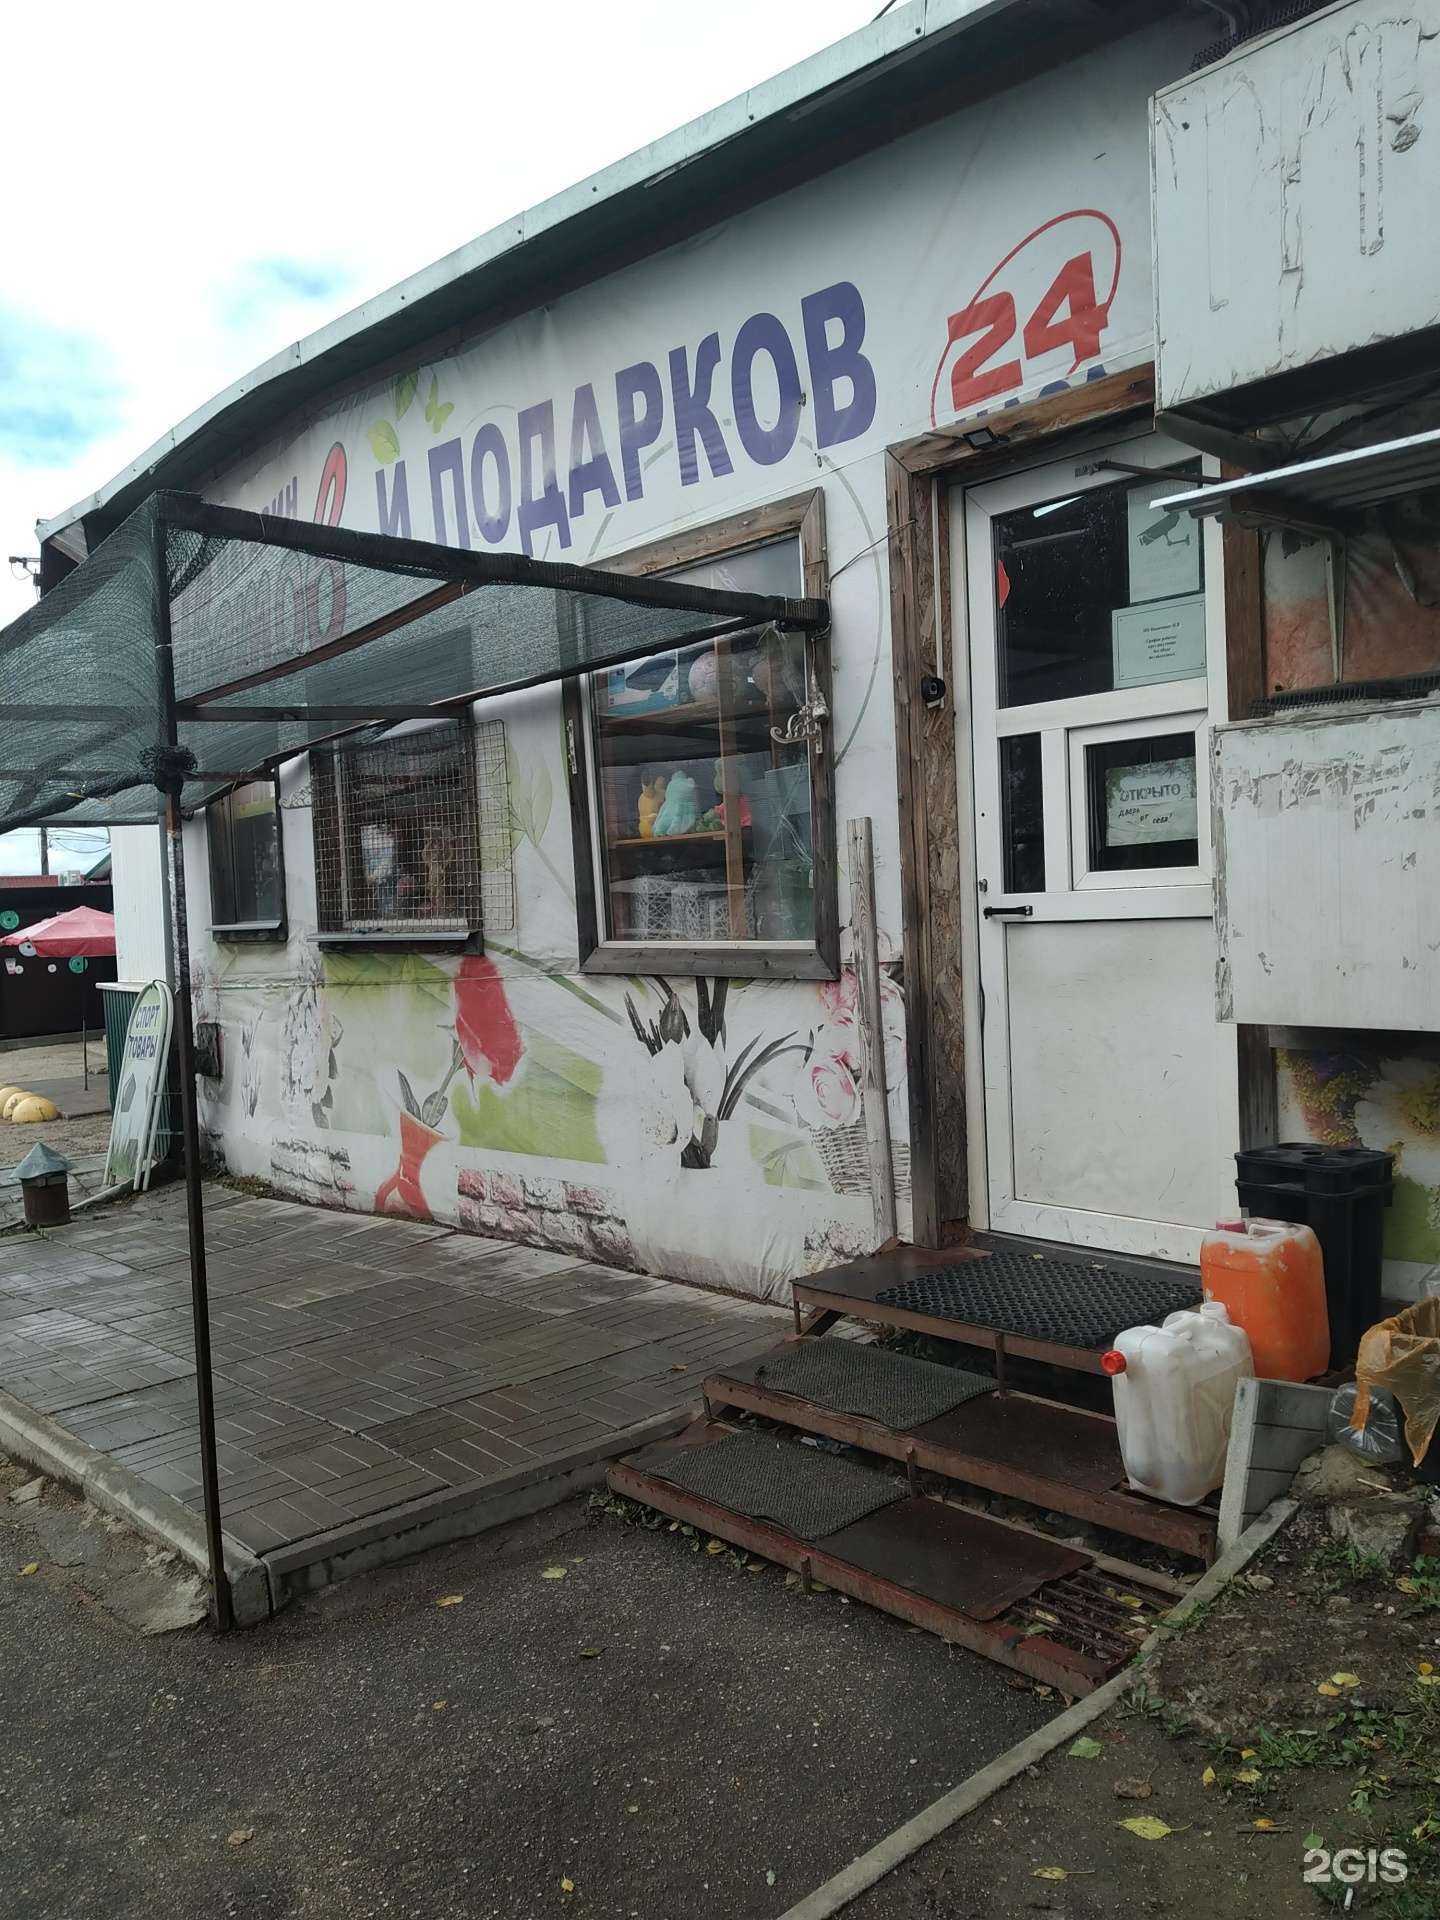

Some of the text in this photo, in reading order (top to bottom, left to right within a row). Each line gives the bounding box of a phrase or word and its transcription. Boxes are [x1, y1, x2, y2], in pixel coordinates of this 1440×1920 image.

[947, 251, 1109, 412] 24
[375, 281, 877, 557] И ПОДАРКОВ
[1119, 784, 1180, 802] ОТКРЫТО
[135, 1005, 160, 1028] СПОРТ
[128, 1034, 159, 1058] ТОВАРЫ
